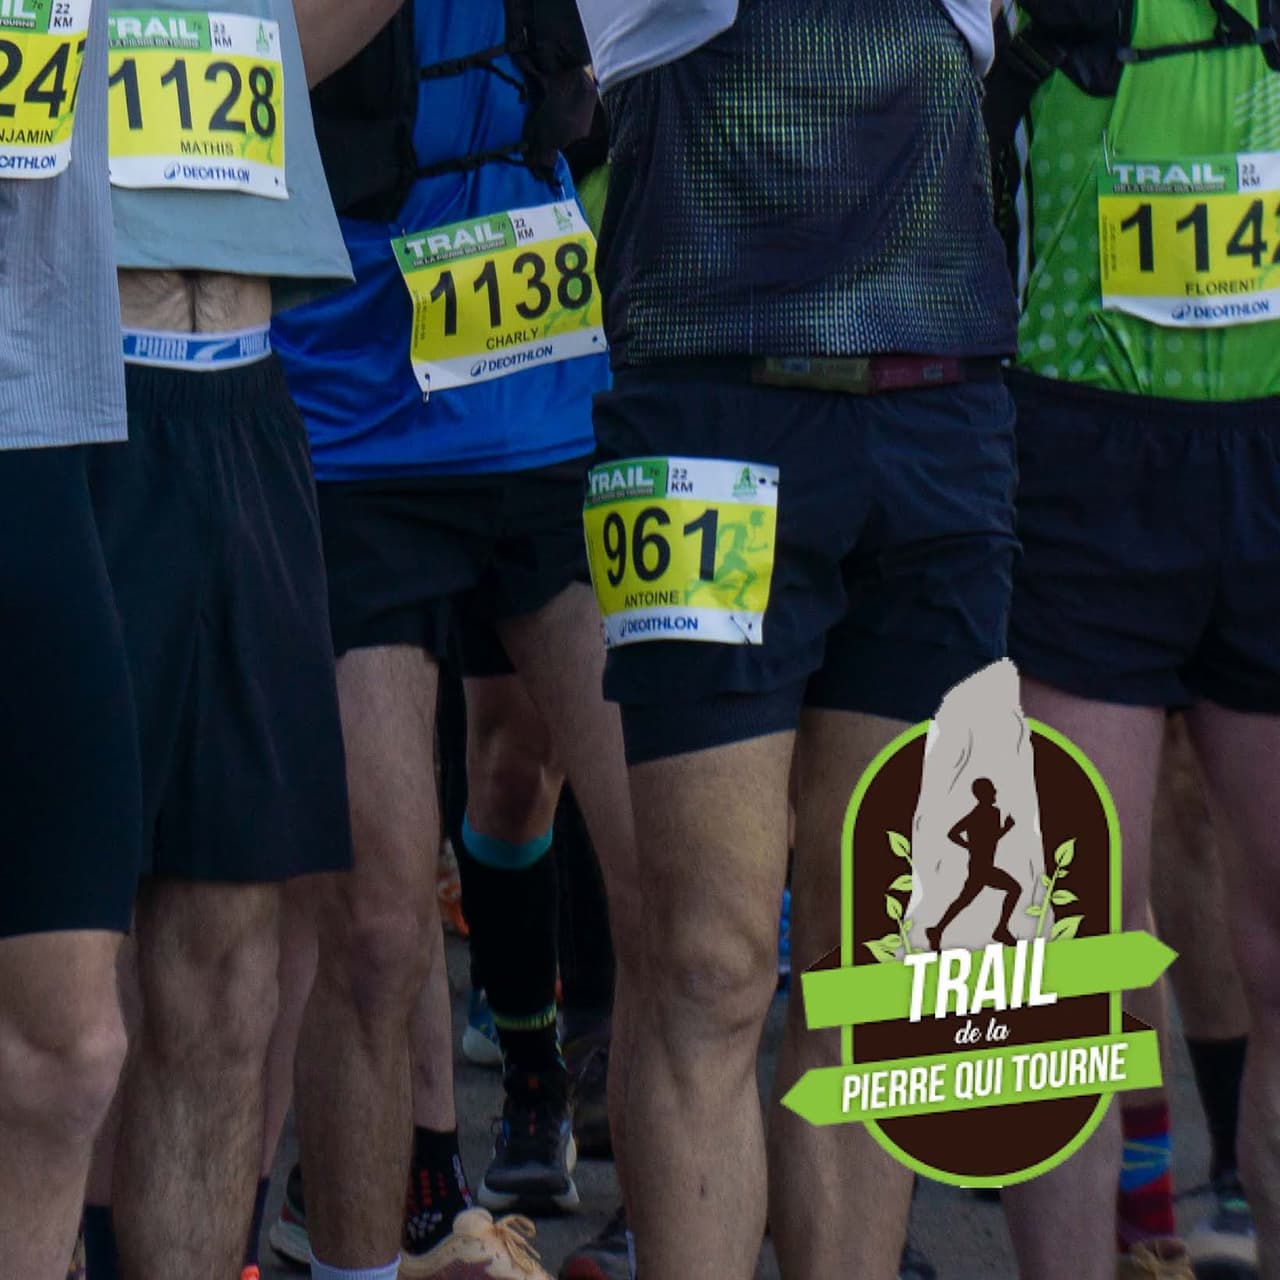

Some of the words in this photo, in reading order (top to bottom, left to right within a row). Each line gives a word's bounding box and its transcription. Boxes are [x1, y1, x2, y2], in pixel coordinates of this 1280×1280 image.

[55, 3, 70, 15] 22
[53, 17, 73, 28] KM
[108, 57, 276, 140] 1128
[180, 140, 234, 156] MATHIS
[183, 165, 250, 184] DECATHLON
[1112, 162, 1225, 185] TRAIL
[515, 218, 526, 229] 22
[407, 223, 505, 259] TRAIL
[517, 228, 535, 241] KM
[430, 242, 593, 337] 1138
[1185, 278, 1257, 297] FLORENT
[1194, 300, 1270, 320] DECATHLON
[135, 335, 188, 361] PUMA
[485, 327, 539, 351] CHARLY
[489, 344, 553, 372] DECATHLON
[588, 466, 655, 496] TRAIL
[671, 482, 694, 494] KM
[603, 506, 719, 588] 961
[624, 590, 680, 609] ANTOINE
[628, 616, 699, 634] DECATHLON
